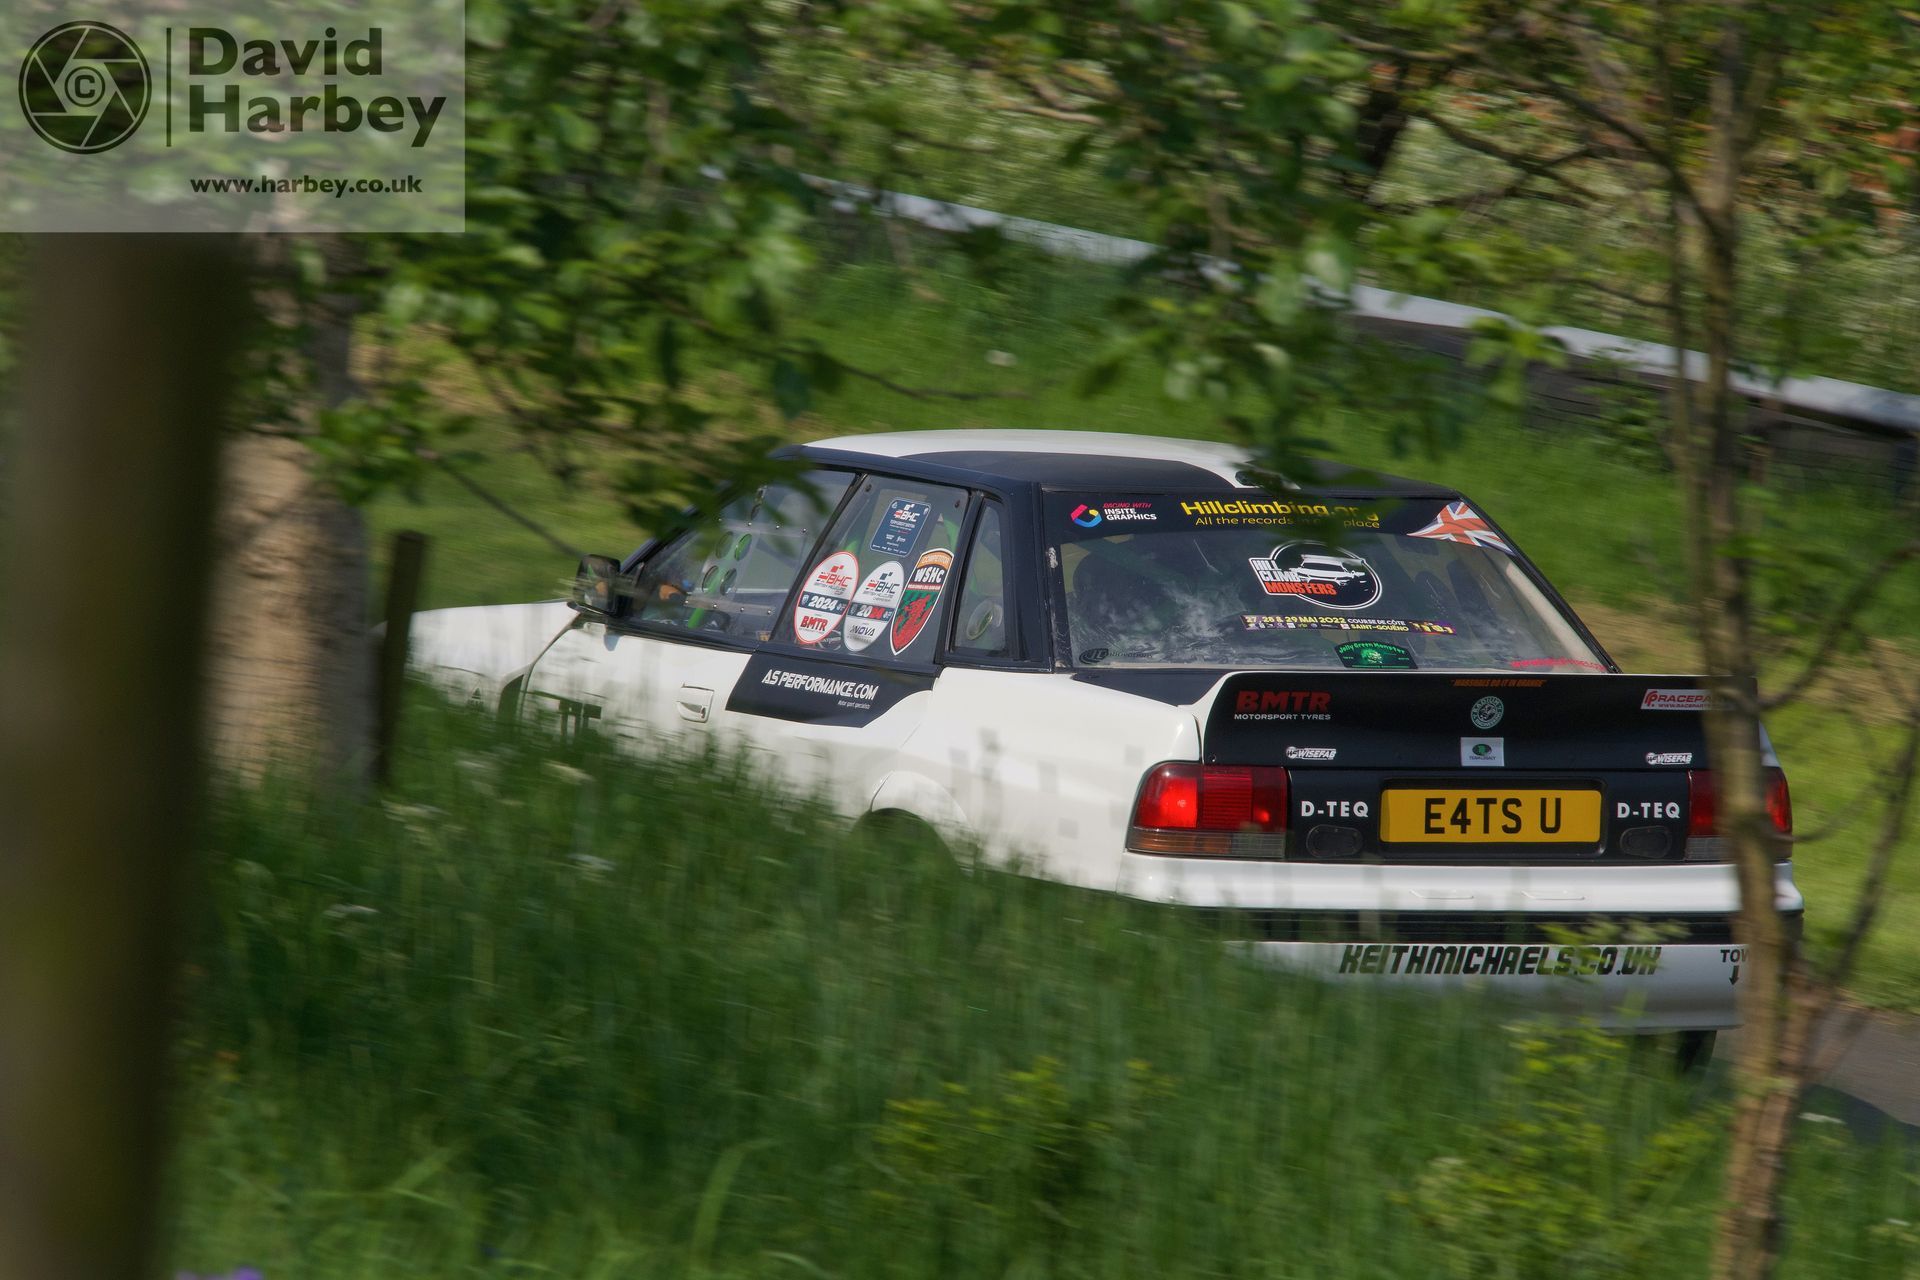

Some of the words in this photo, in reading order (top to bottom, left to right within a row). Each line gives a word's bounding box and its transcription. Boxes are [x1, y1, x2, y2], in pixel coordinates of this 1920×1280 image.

[1106, 513, 1157, 521] GRAPHICS
[1180, 500, 1379, 521] Hillclimbing.or
[1195, 517, 1212, 526] All
[1216, 516, 1239, 525] the
[1242, 516, 1294, 525] records
[1343, 517, 1380, 529] place
[1251, 560, 1281, 570] HILL
[914, 566, 945, 583] WSHC
[1258, 569, 1301, 582] CLIMB
[874, 581, 900, 595] BHC
[1264, 581, 1337, 595] MONSTERS
[808, 595, 839, 611] 2024
[800, 615, 829, 631] BMTR
[761, 669, 781, 685] AS
[777, 672, 879, 700] PERFORMANCE.COM
[1234, 690, 1332, 713] BMTR
[1298, 749, 1336, 759] WISEFAB
[1657, 753, 1692, 764] WISEFAB
[1301, 801, 1369, 818] D-TEQ
[1424, 797, 1522, 834] E4TS
[1540, 797, 1562, 834] U
[1617, 802, 1680, 818] D-TEQ
[1338, 944, 1662, 976] KEITHMICHAELS.CO.UK
